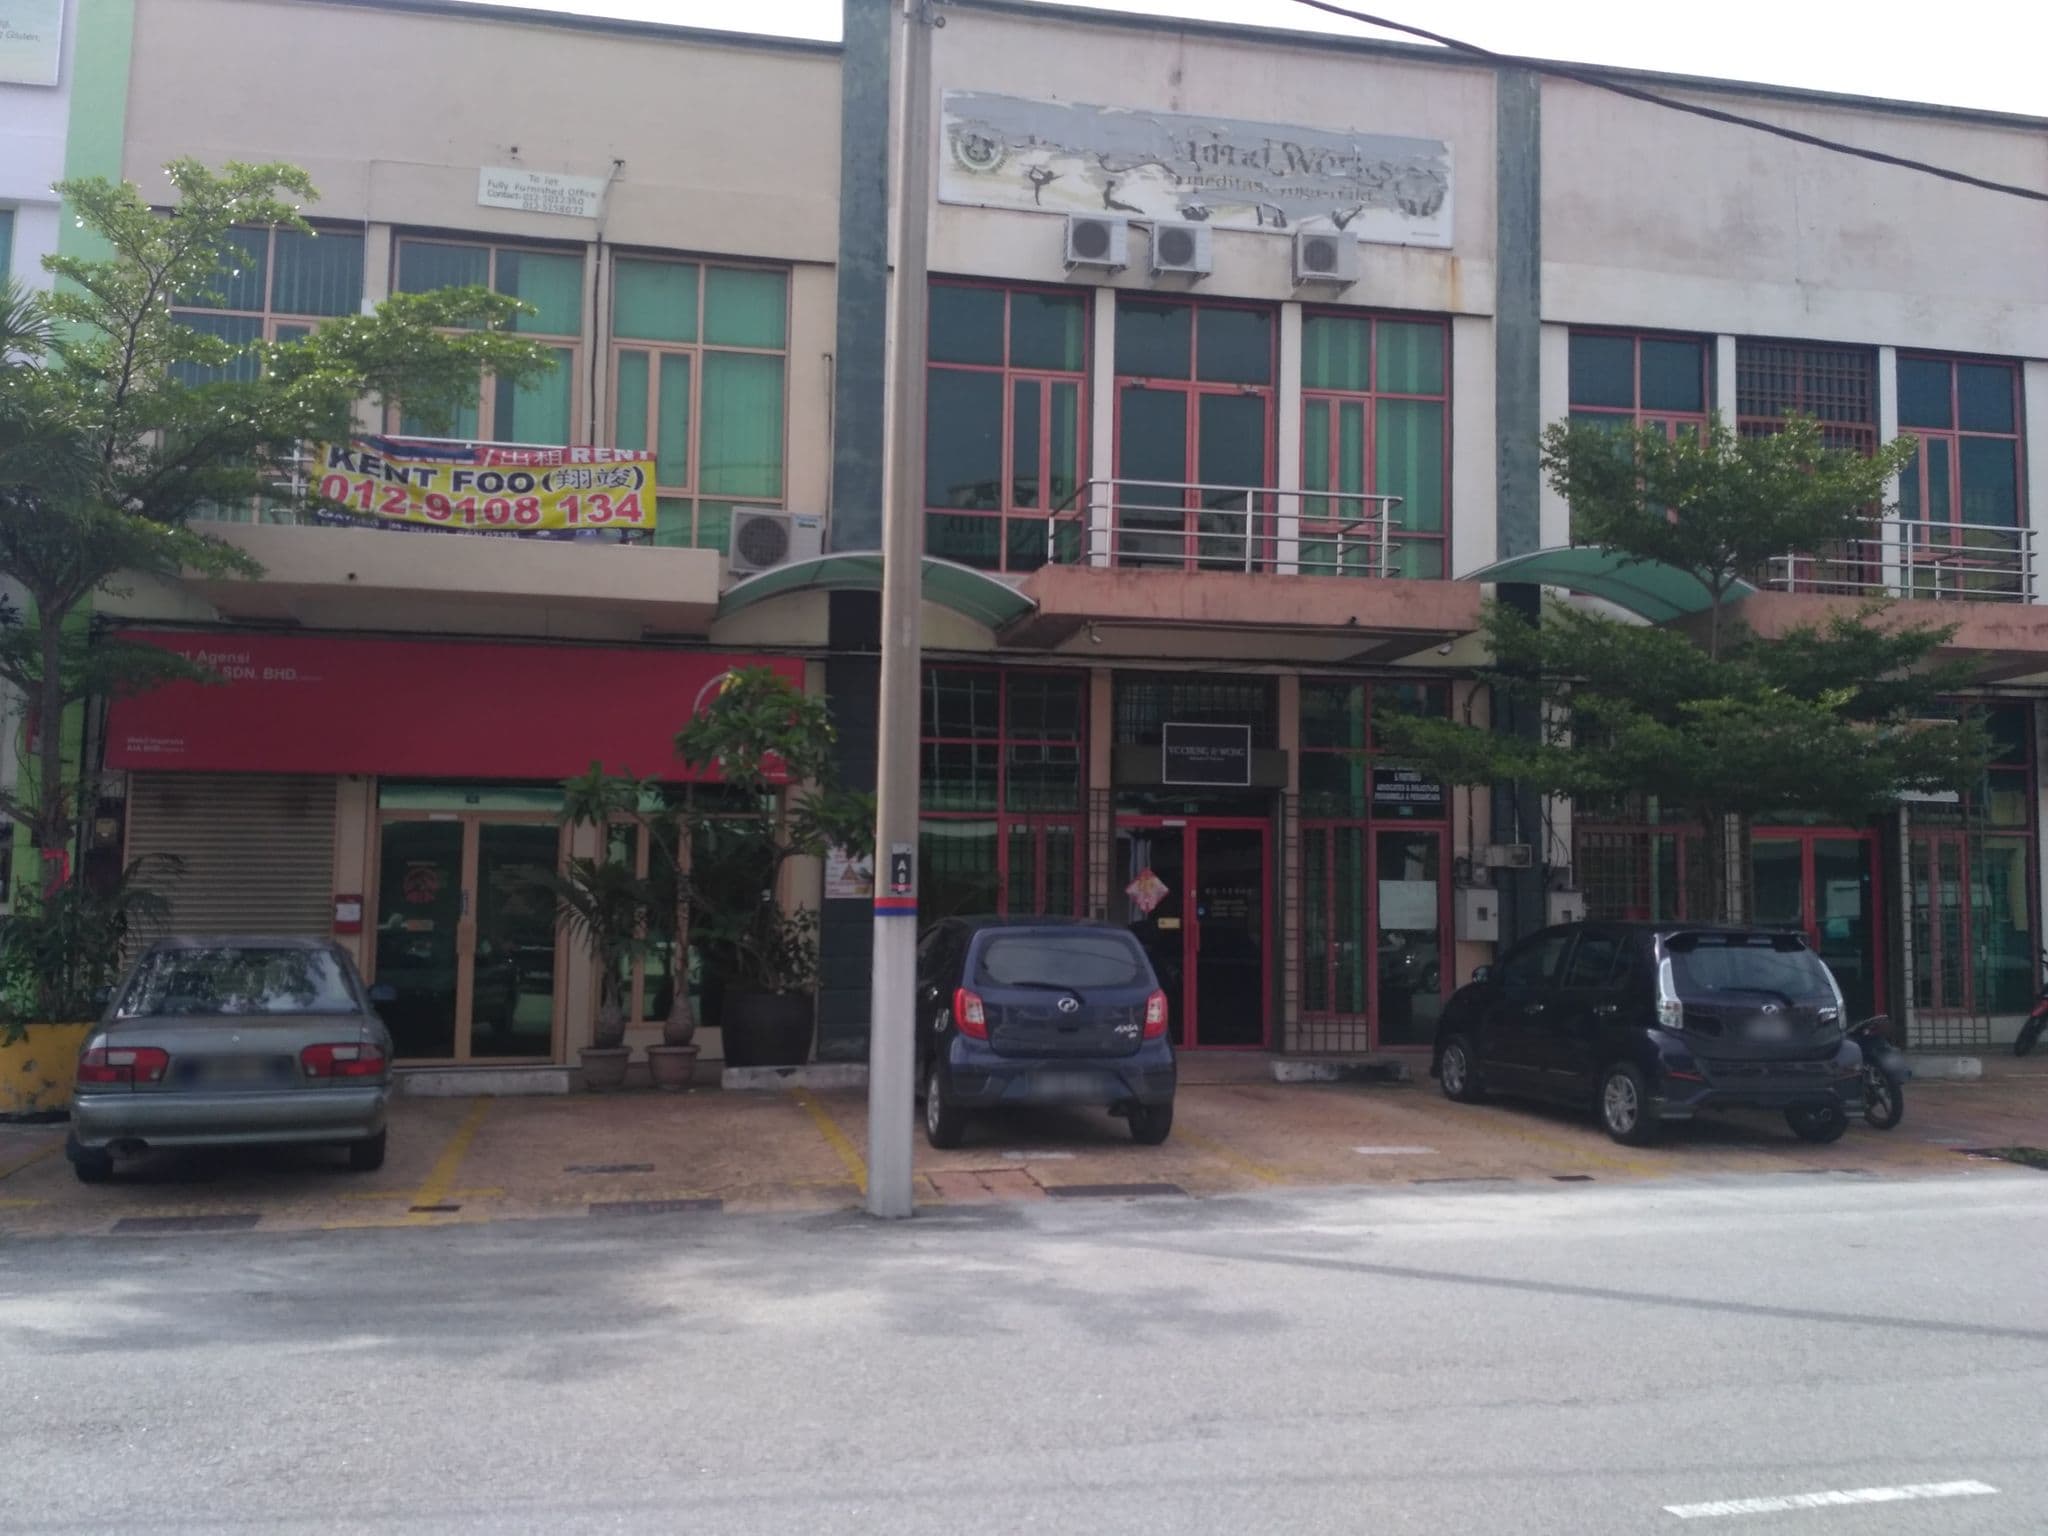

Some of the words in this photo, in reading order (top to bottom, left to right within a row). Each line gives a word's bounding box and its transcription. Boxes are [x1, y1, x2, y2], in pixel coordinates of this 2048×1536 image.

[515, 183, 564, 197] Furnished
[568, 188, 597, 199] Office
[501, 450, 562, 466] 出租
[328, 445, 438, 487] KENT
[452, 469, 535, 494] FOO
[319, 473, 541, 525] 012-9108
[558, 493, 643, 524] 134
[195, 649, 250, 666] Agensi
